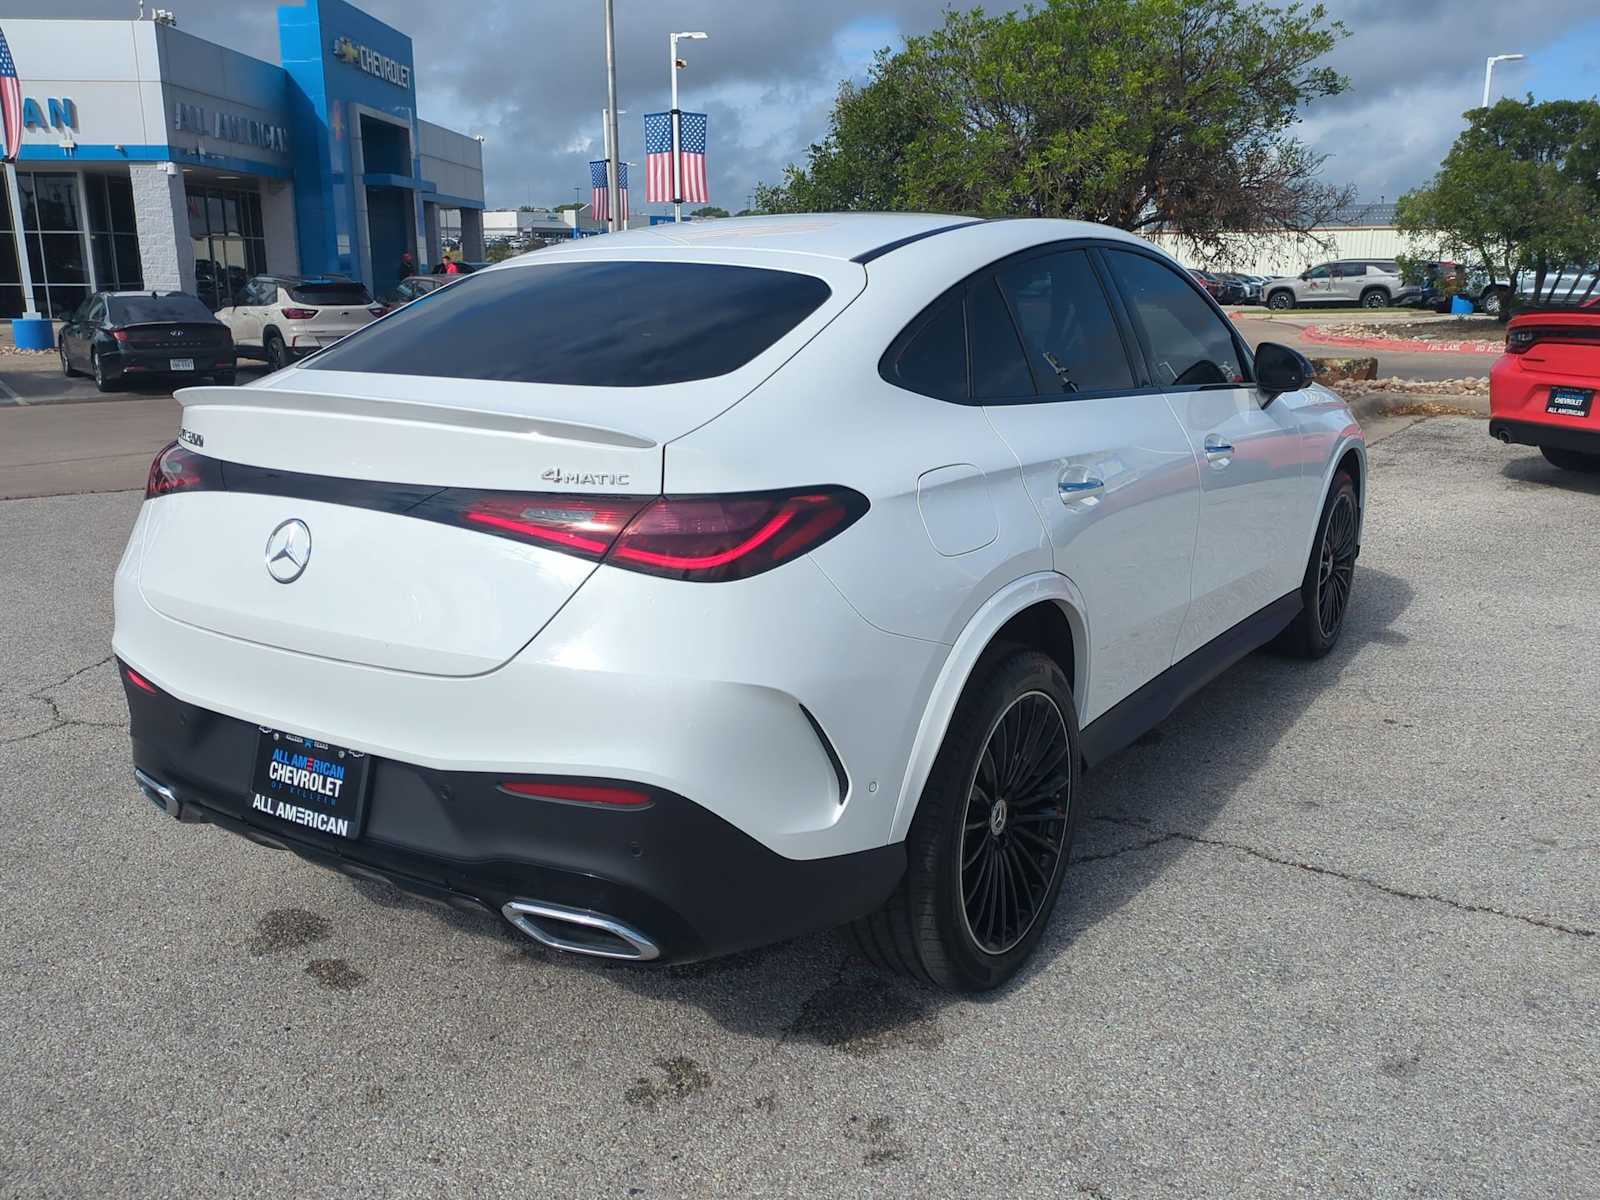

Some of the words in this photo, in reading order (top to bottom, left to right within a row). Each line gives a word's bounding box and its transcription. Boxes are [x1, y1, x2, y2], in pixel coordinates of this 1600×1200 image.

[360, 45, 410, 89] CHEVROLET
[1554, 397, 1583, 406] CHEVROLET
[1557, 408, 1585, 417] AMERICAN
[314, 741, 329, 750] TEXAS
[272, 749, 289, 764] ALL
[291, 753, 344, 778] AMERICAN
[269, 761, 343, 797] CHEVROLET
[271, 781, 283, 792] OF
[289, 786, 336, 805] KILLEEN
[252, 793, 274, 815] ALL
[276, 802, 348, 836] AMERICAN
